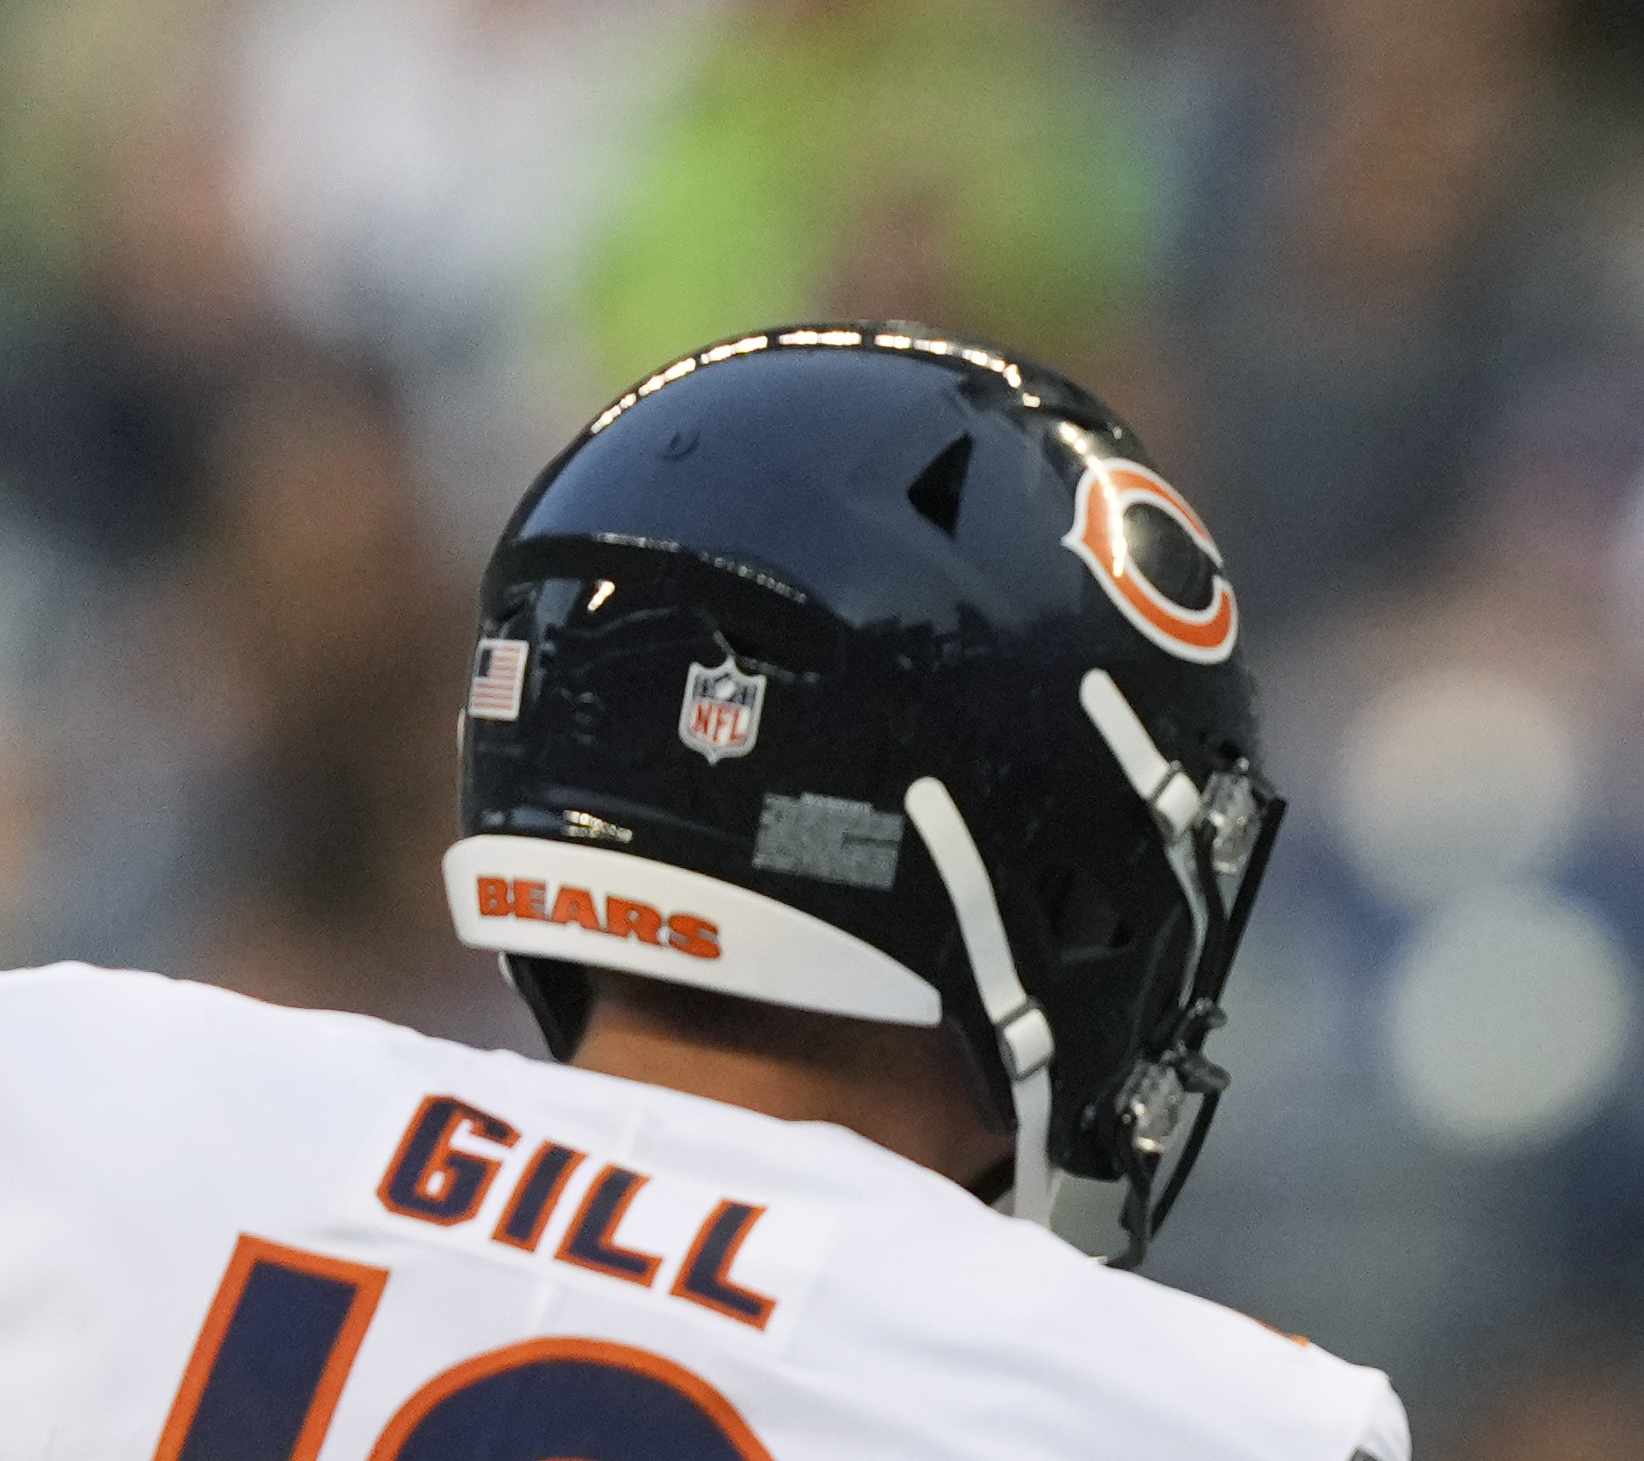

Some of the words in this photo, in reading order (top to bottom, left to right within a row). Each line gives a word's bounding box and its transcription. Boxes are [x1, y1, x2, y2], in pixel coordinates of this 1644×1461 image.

[1062, 457, 1238, 664] C
[693, 704, 748, 742] NFL
[477, 876, 721, 959] BEARS
[376, 1094, 777, 1331] GILL
